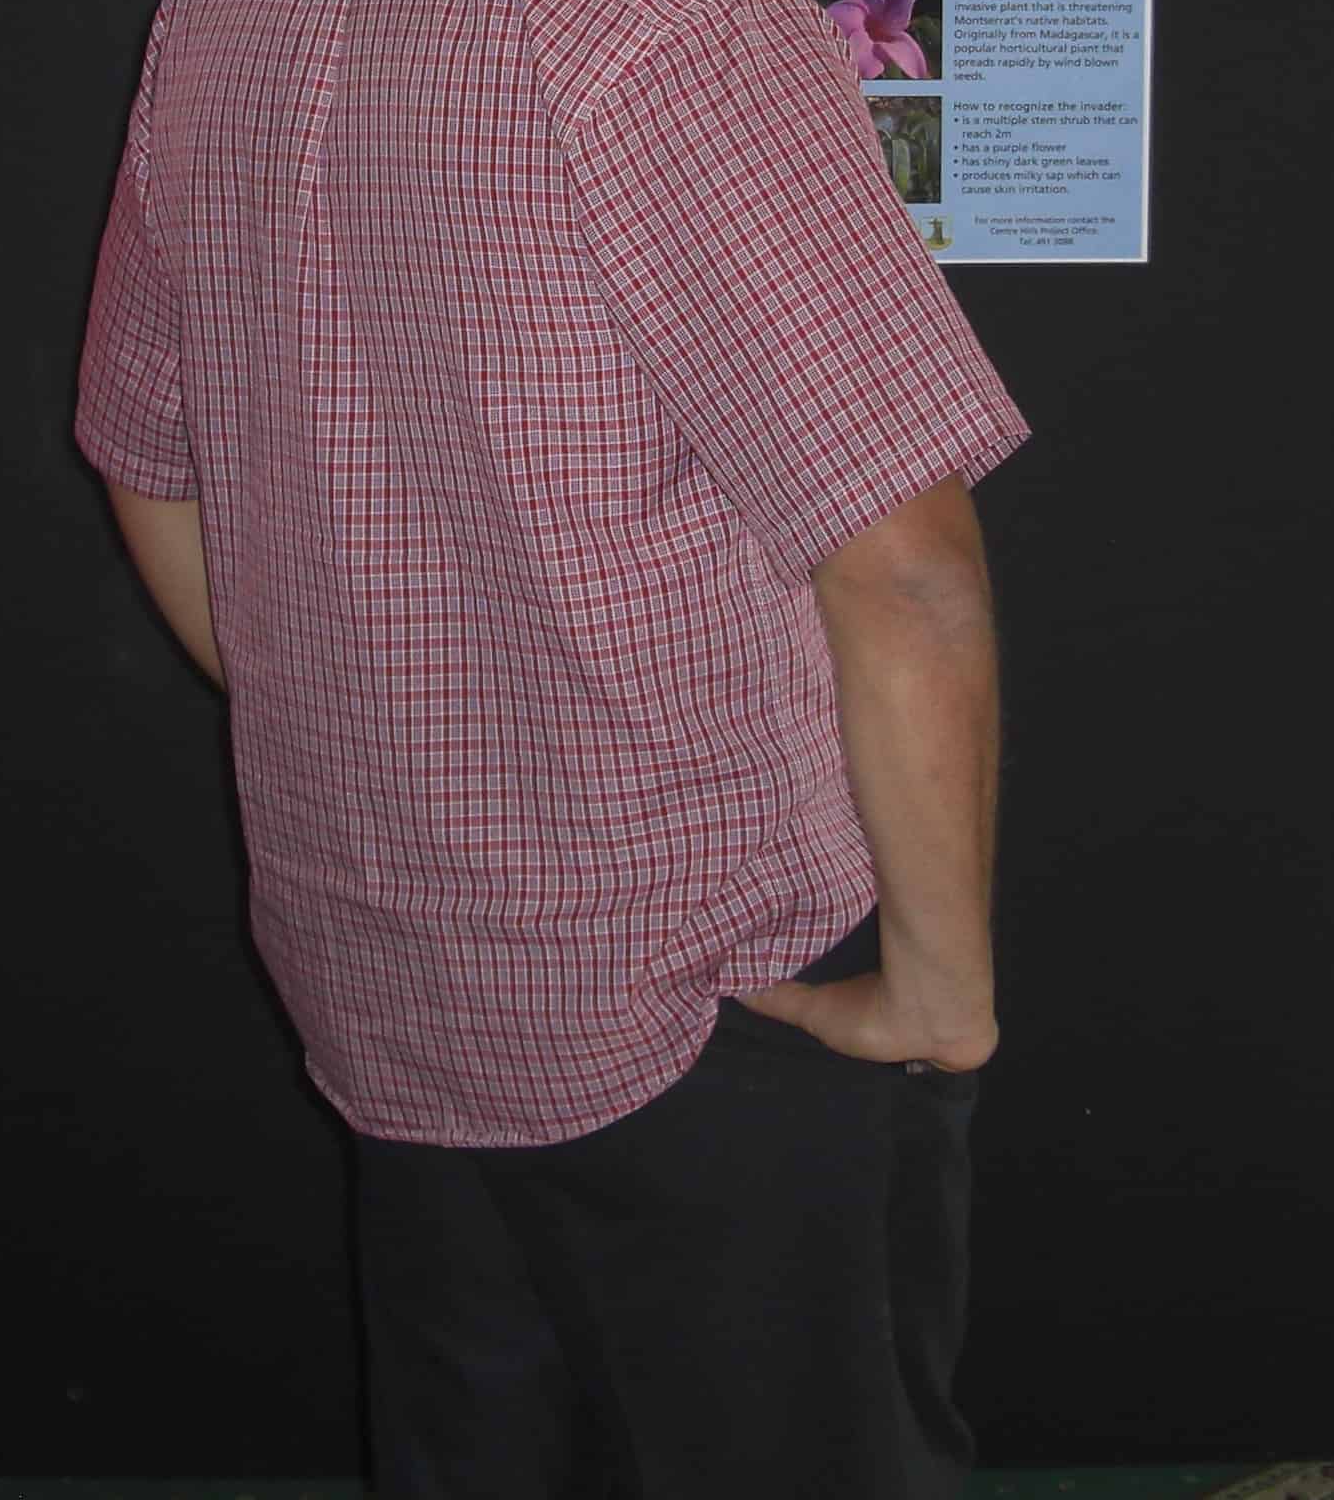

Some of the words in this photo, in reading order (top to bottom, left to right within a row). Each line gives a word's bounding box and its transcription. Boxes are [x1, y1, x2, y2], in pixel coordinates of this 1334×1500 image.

[954, 2, 997, 12] invasive
[1000, 2, 1028, 14] plant
[1031, 2, 1054, 12] that
[1068, 2, 1133, 14] threatening
[954, 16, 1023, 26] Montserrat's
[1025, 16, 1060, 26] native
[1062, 16, 1109, 26] habitats.
[954, 29, 1007, 42] Originally
[1010, 29, 1037, 40] from
[1039, 30, 1108, 42] Madagascar,
[954, 43, 997, 55] popular
[999, 43, 1068, 54] horticultural
[1070, 43, 1100, 55] plant
[1102, 43, 1125, 54] that
[954, 57, 995, 69] spreads
[997, 57, 1036, 70] rapidly
[1037, 57, 1052, 69] by
[1053, 57, 1082, 68] wind
[1084, 57, 1120, 68] blown
[954, 71, 987, 82] seeds.
[953, 102, 980, 112] How
[982, 102, 996, 112] to
[998, 102, 1055, 114] recognize
[1057, 102, 1077, 112] the
[982, 116, 1028, 127] multiple
[1030, 117, 1058, 126] stem
[1059, 116, 1091, 126] shrub
[1093, 116, 1116, 126] that
[1118, 117, 1139, 126] can
[962, 130, 992, 140] reach
[994, 130, 1013, 140] 2m
[961, 143, 981, 153] has
[992, 144, 1028, 155] purple
[1031, 143, 1068, 153] flower
[961, 157, 981, 167] has
[983, 157, 1011, 169] shiny
[1013, 157, 1039, 167] dark
[1041, 159, 1073, 169] green
[1075, 157, 1111, 167] leaves
[961, 171, 1012, 182] produces
[1013, 171, 1043, 182] milky
[1045, 173, 1065, 183] sap
[1066, 171, 1100, 182] which
[1101, 173, 1122, 182] can
[961, 185, 992, 195] cause
[994, 185, 1017, 195] skin
[1018, 185, 1069, 196] irritation.
[1039, 227, 1070, 238] Project
